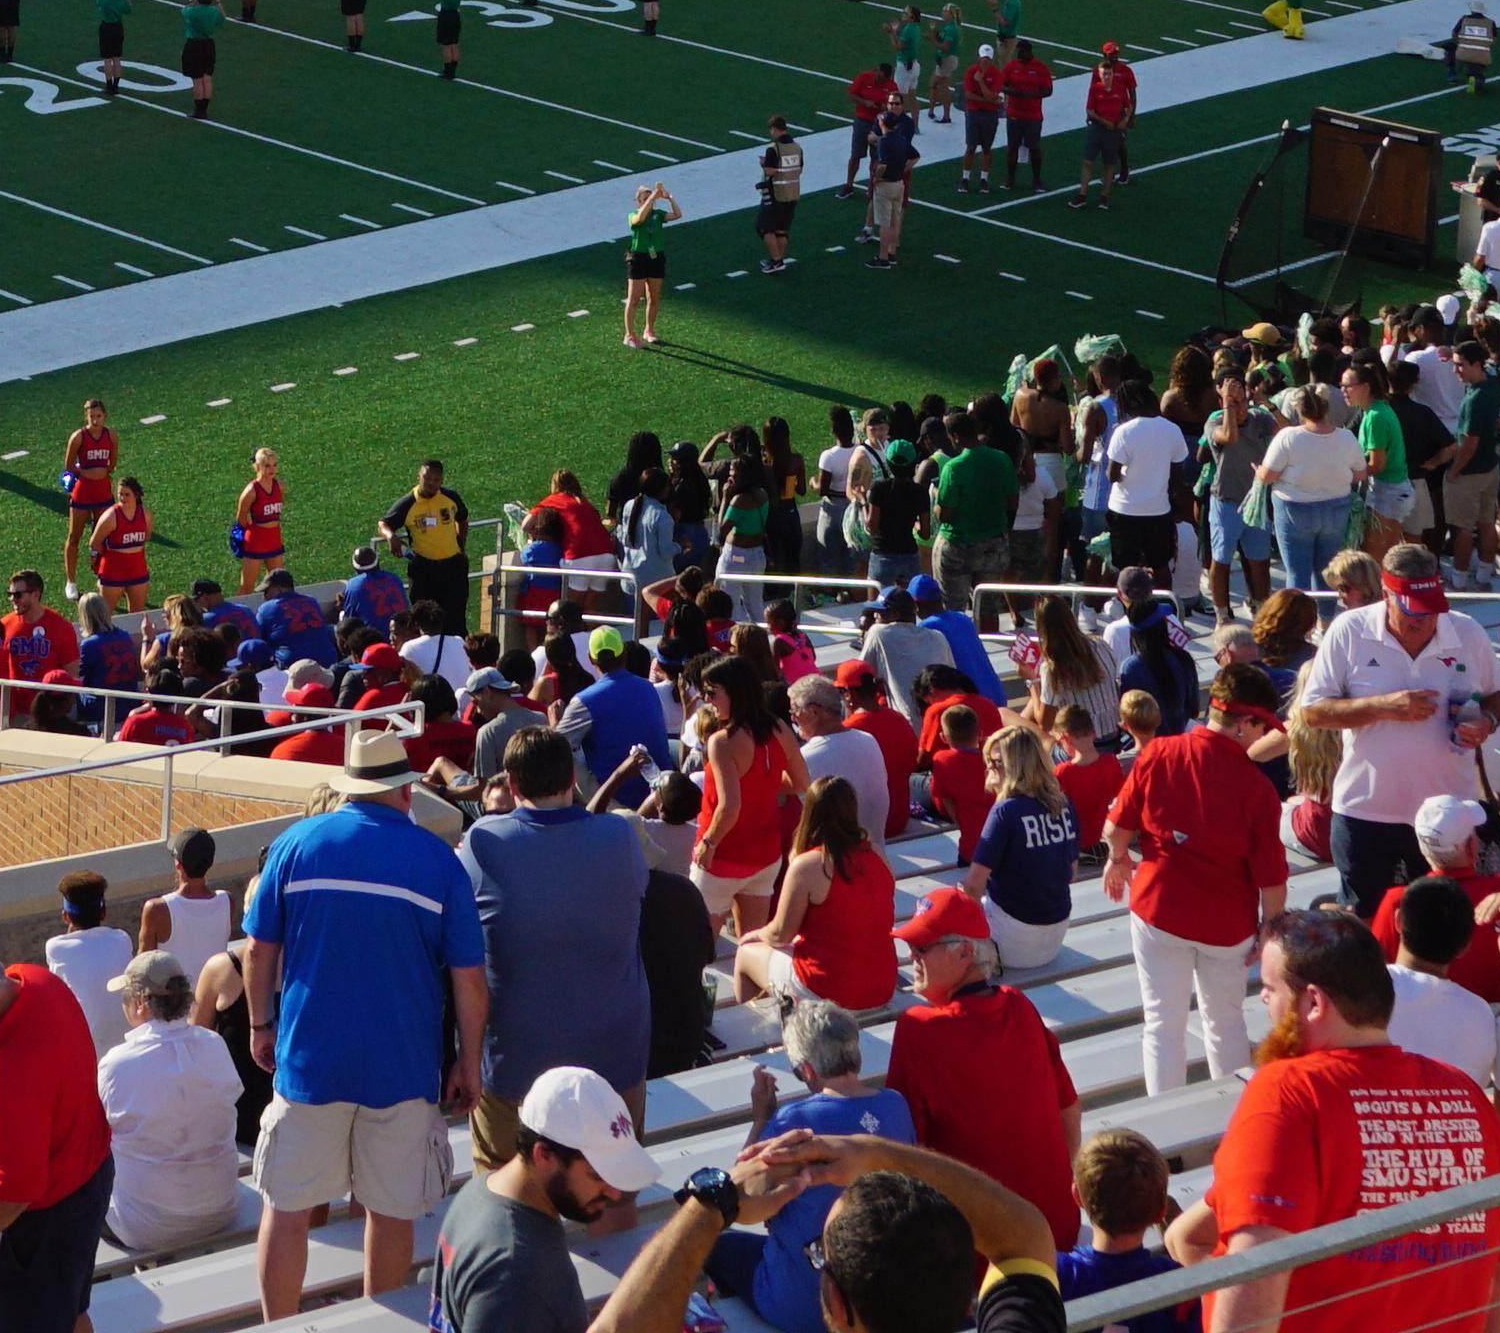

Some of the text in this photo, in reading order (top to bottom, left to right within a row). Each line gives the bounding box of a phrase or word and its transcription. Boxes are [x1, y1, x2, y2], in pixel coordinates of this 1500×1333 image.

[86, 449, 110, 461] SMU
[122, 532, 146, 544] SMU
[9, 635, 52, 658] SMU
[1021, 807, 1077, 849] RISE
[1440, 1100, 1477, 1113] DOLL
[1358, 1120, 1385, 1132] THE
[1387, 1120, 1417, 1132] BEST
[1360, 1132, 1395, 1144] BAND
[1447, 1131, 1483, 1143] LAND
[1362, 1148, 1485, 1168] THE HUB OF
[1362, 1166, 1486, 1188] SMU SPIRIT
[1360, 1191, 1386, 1204] THE
[1447, 1223, 1486, 1234] YEARS
